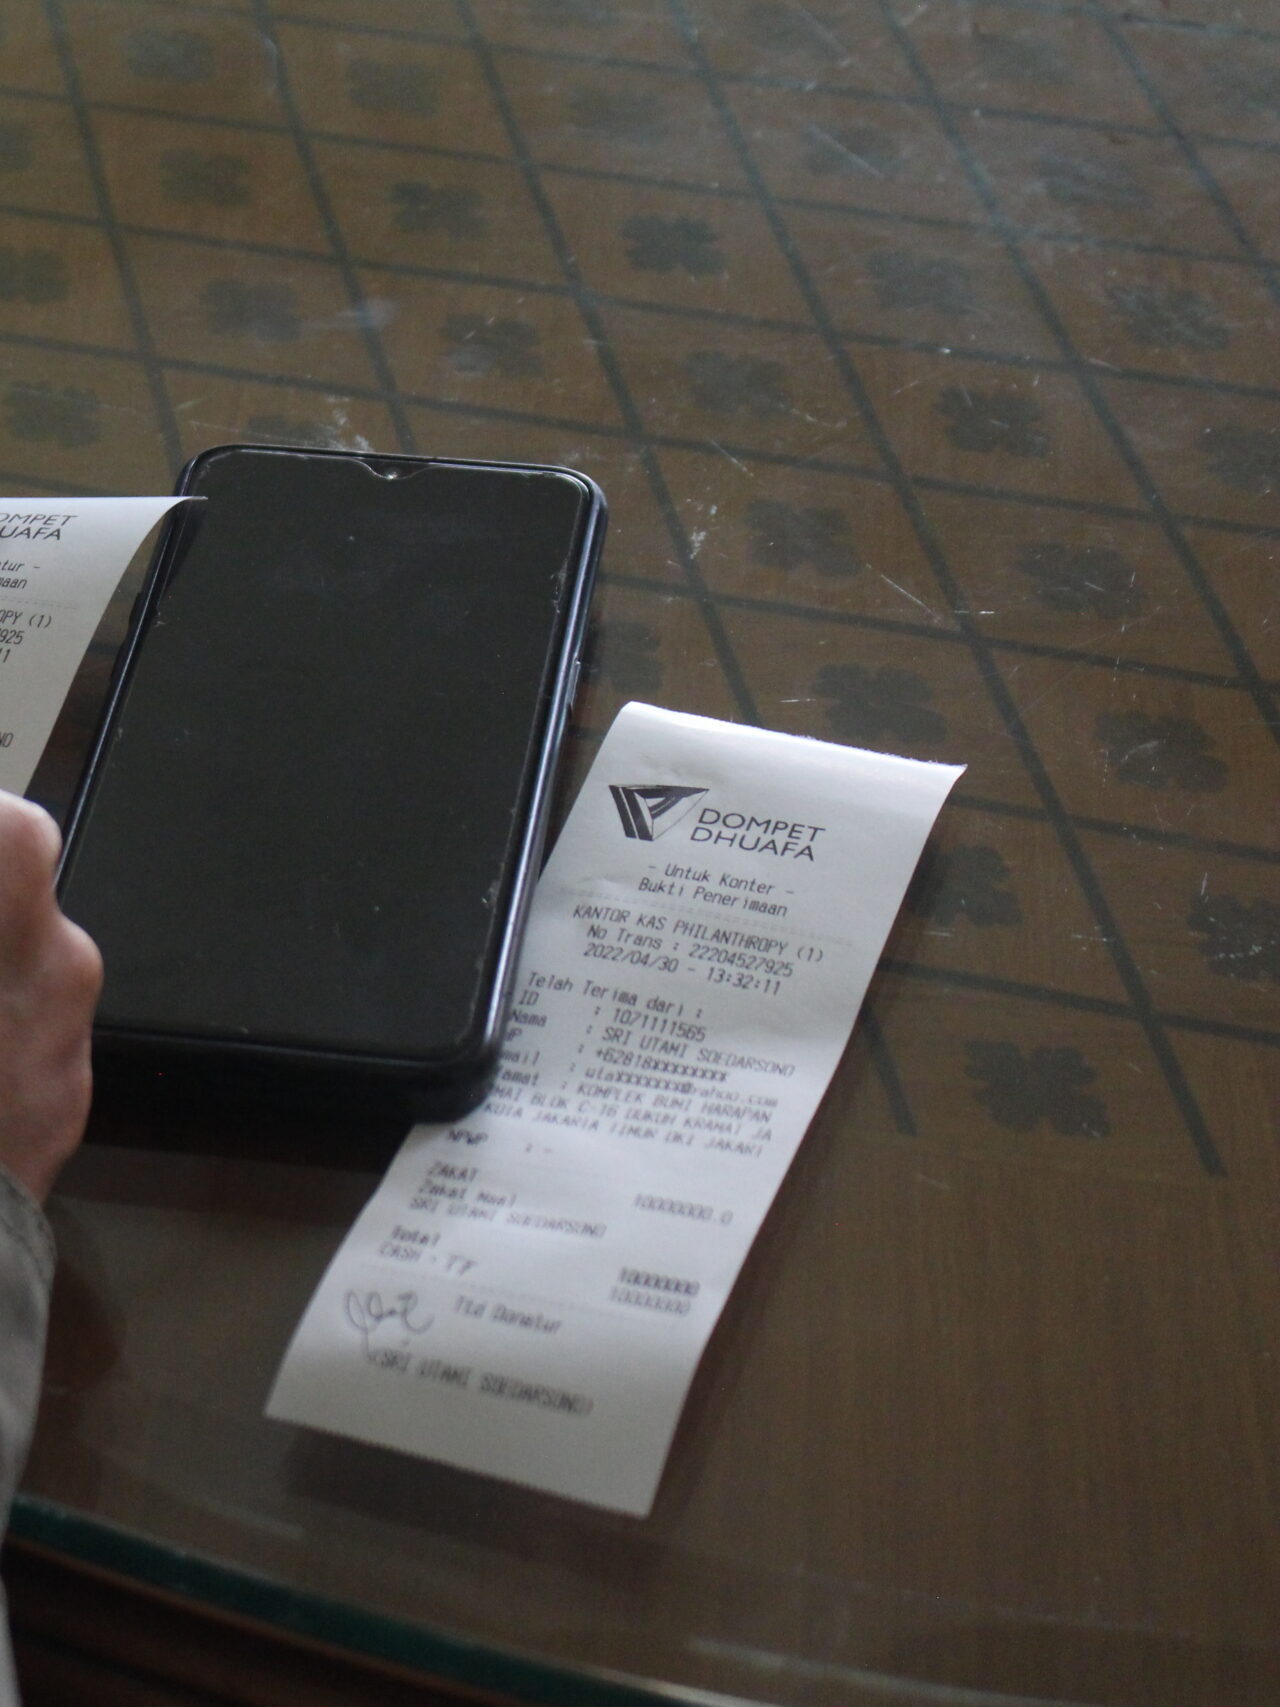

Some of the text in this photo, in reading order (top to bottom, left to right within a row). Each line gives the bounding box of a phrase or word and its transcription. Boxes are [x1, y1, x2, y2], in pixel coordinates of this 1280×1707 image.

[29, 614, 52, 629] (1)
[690, 826, 816, 861] DHUAFA
[698, 808, 826, 843] DOMPET
[639, 877, 788, 917] Bukti Penerimaan
[664, 863, 711, 883] Untuk
[719, 872, 775, 895] Konter
[573, 905, 824, 963] KANTOR KAS PHILANTHROPY (1)
[587, 925, 608, 940] No
[619, 928, 663, 951] Trans
[688, 944, 795, 978] 22204527925
[583, 943, 680, 973] 2022/04/30
[707, 966, 781, 996] 13:32:11
[527, 971, 574, 992] Telah
[582, 980, 639, 1006] Terima
[646, 996, 684, 1016] dari
[510, 1010, 548, 1027] Nama
[602, 1026, 632, 1046] SRI
[640, 1035, 689, 1057] UTAMI
[519, 990, 540, 1006] ID
[613, 1008, 707, 1042] 1071111565
[500, 1050, 540, 1066] mail
